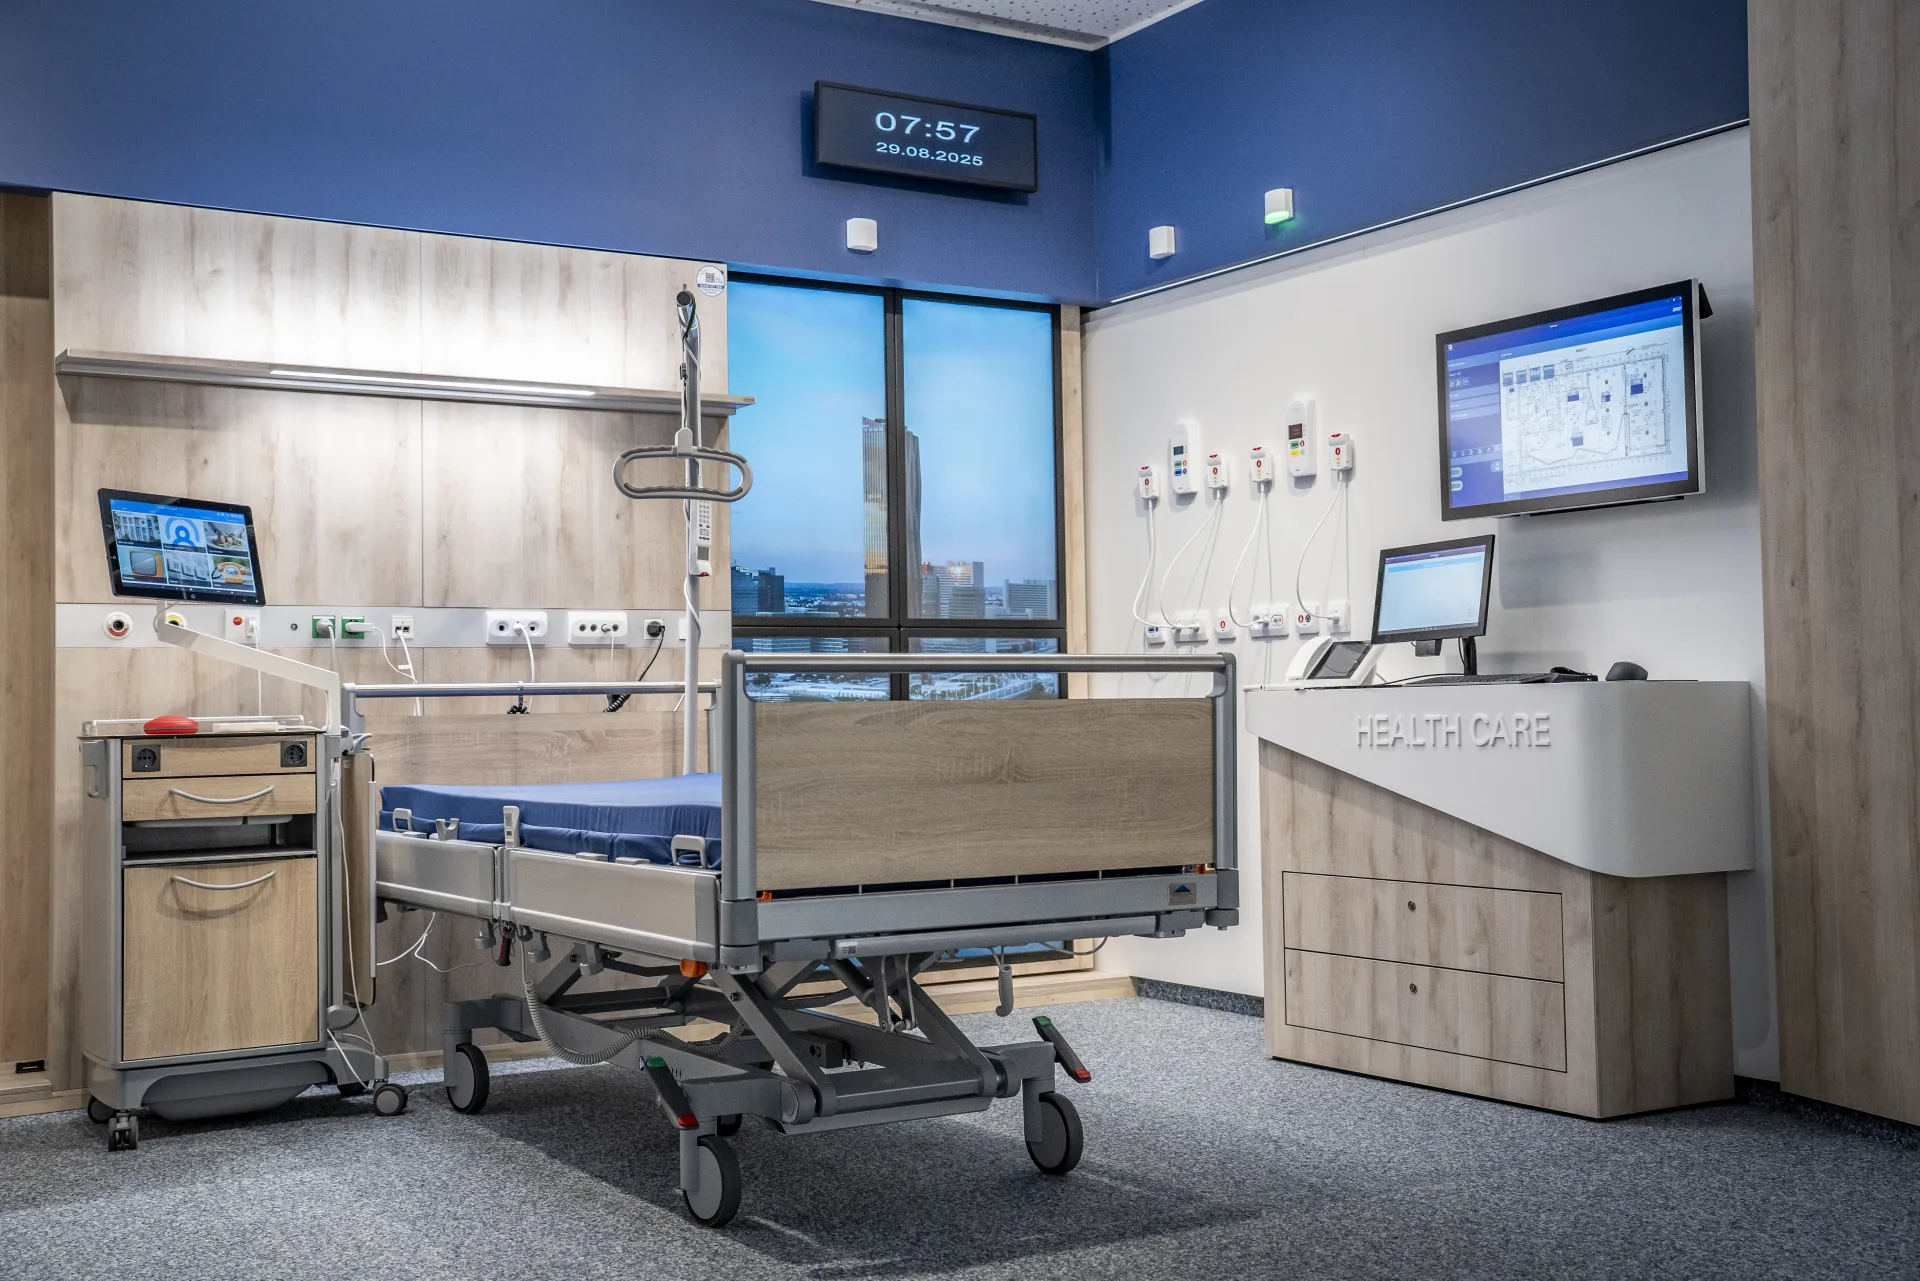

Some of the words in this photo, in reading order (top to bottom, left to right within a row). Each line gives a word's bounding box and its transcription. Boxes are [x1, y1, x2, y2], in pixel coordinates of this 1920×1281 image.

[875, 112, 980, 142] 07:57
[876, 142, 983, 166] 29.08.2025
[1356, 713, 1463, 748] HEALTH
[1470, 712, 1551, 748] CARE
